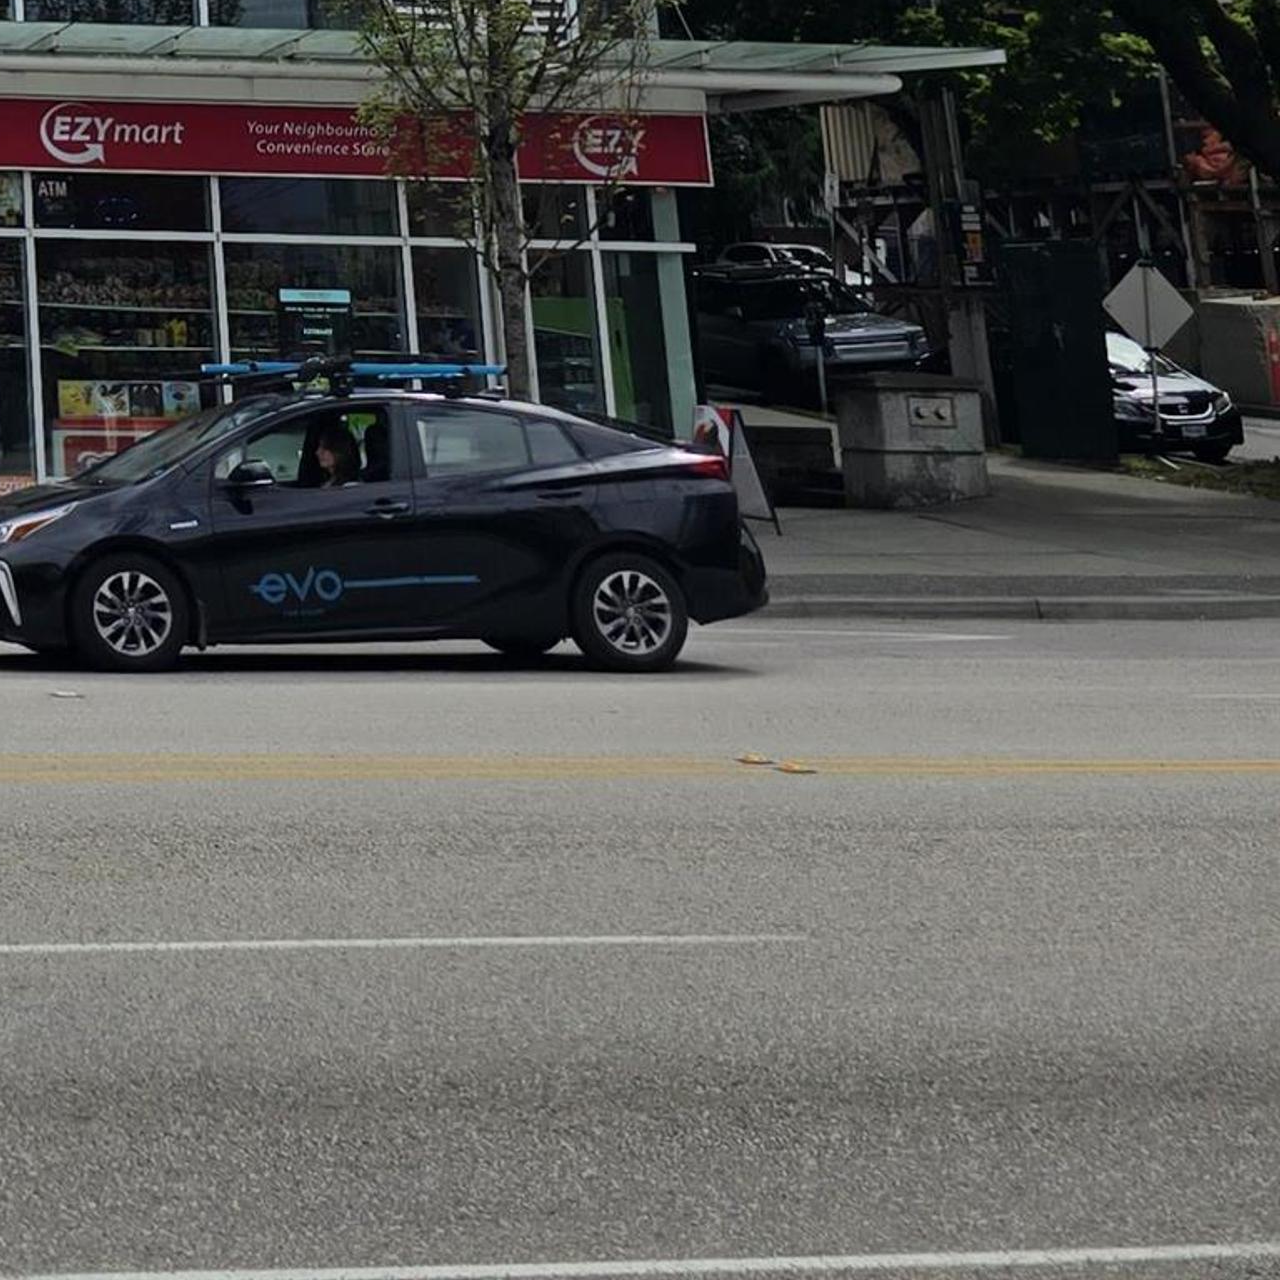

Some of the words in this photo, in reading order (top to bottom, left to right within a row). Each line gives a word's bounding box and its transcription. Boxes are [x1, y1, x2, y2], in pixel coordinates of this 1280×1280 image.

[246, 121, 279, 134] Your
[255, 139, 349, 156] Convenience
[351, 143, 391, 157] Store
[584, 128, 647, 154] EZY
[37, 180, 67, 197] ATM
[257, 566, 344, 604] evo
